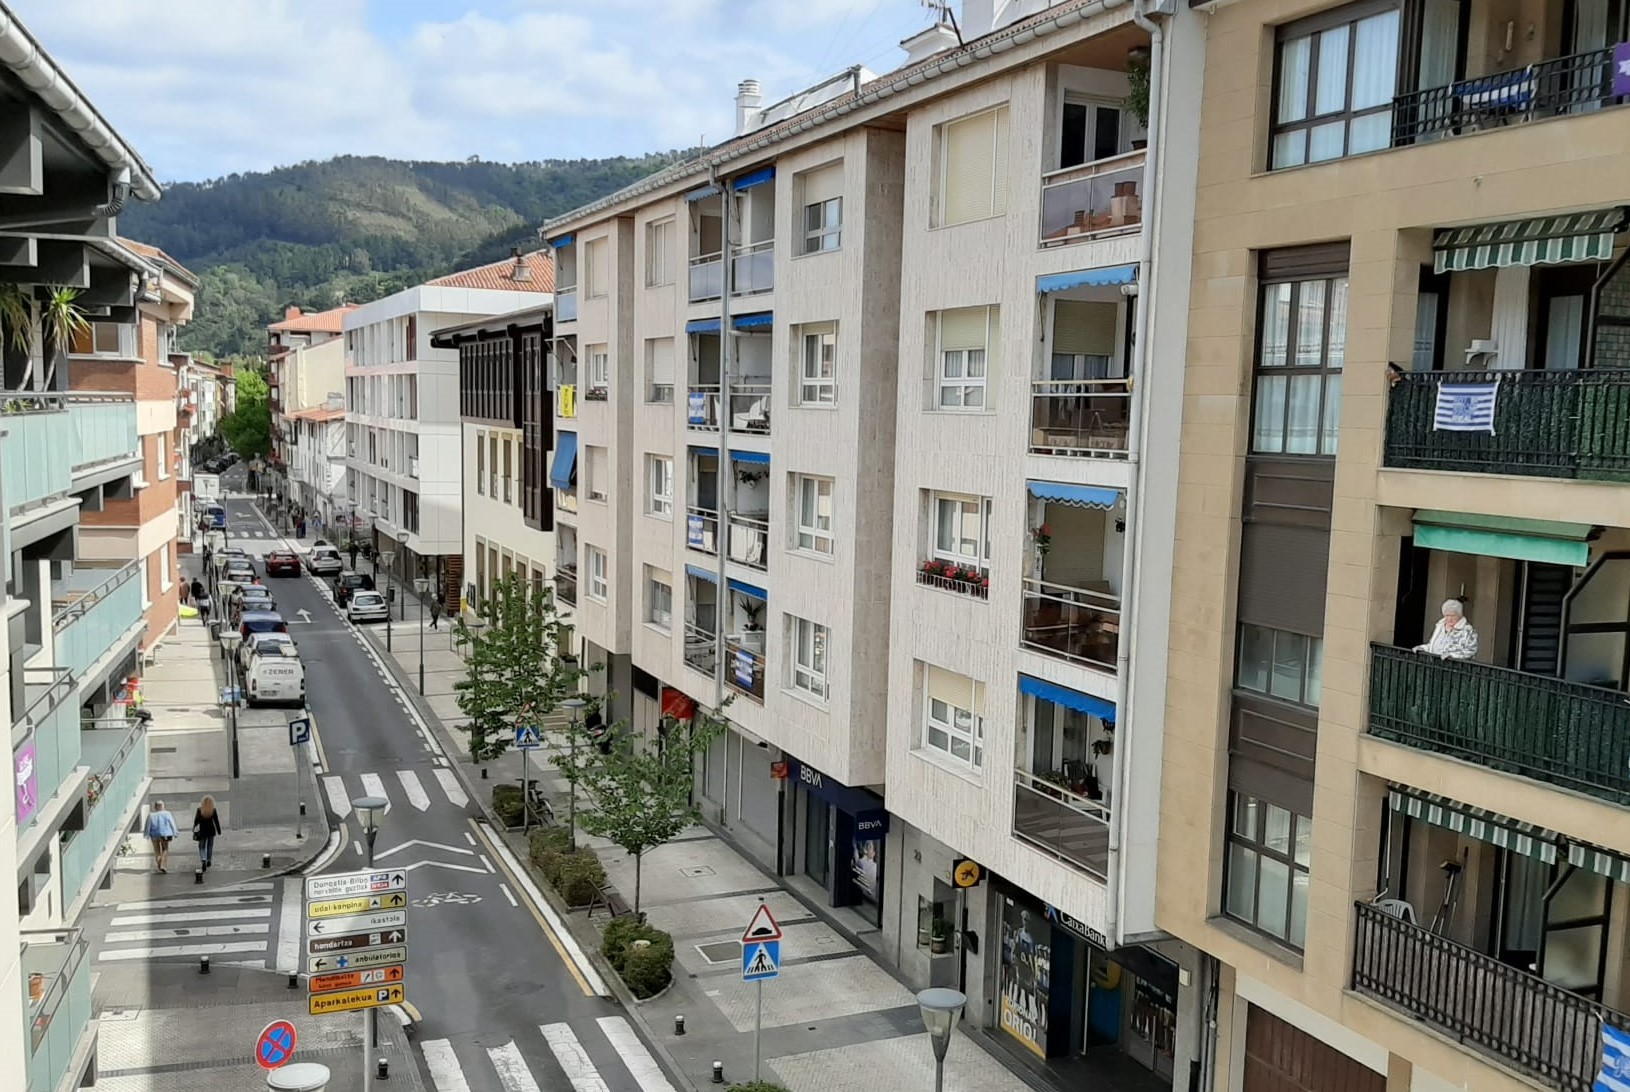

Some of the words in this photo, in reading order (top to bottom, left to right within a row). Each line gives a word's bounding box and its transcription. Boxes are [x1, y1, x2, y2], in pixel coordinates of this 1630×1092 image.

[292, 721, 306, 744] P
[800, 764, 822, 789] BBVA
[858, 820, 882, 830] BBVA
[1060, 911, 1106, 947] CaixaBank
[314, 994, 372, 1009] Aparkalekua
[379, 990, 388, 1001] P
